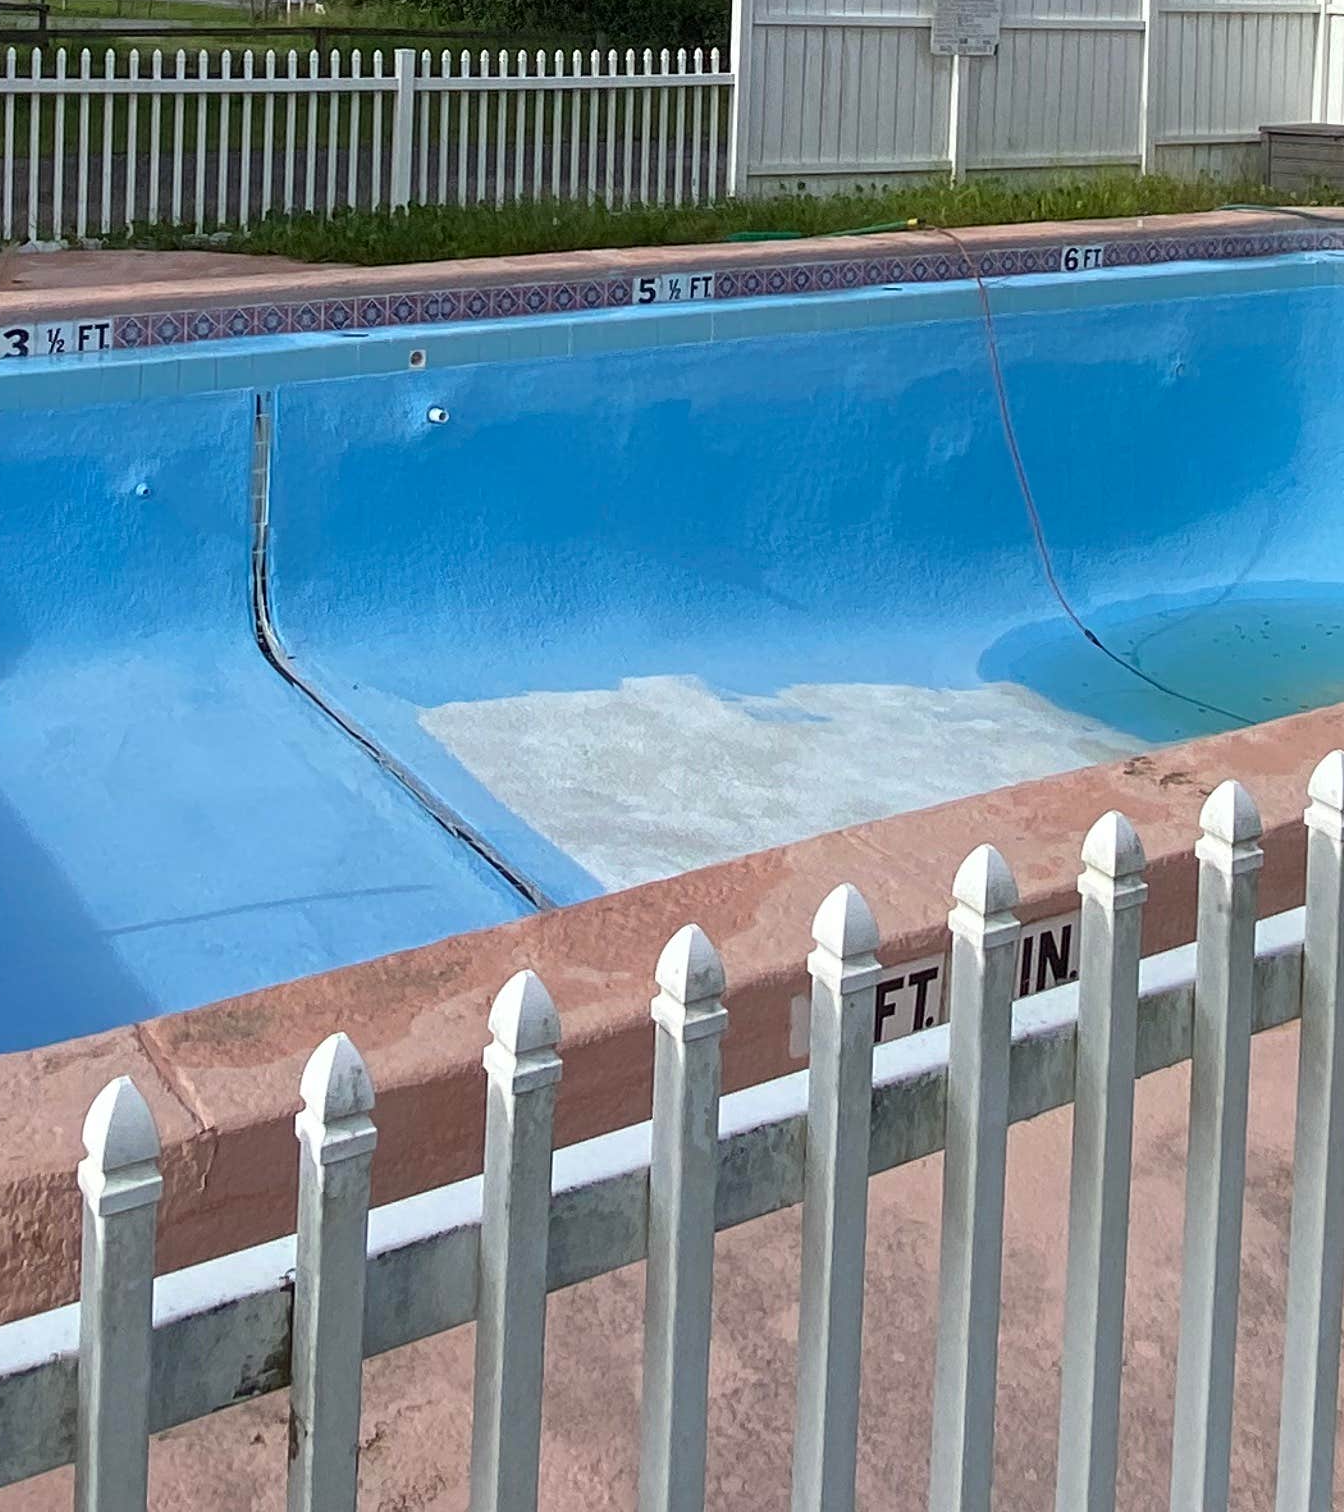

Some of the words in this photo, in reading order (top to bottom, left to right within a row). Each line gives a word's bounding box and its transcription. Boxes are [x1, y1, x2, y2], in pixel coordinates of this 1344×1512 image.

[1064, 248, 1079, 271] 6
[638, 278, 656, 304] 5
[3, 328, 30, 358] 3
